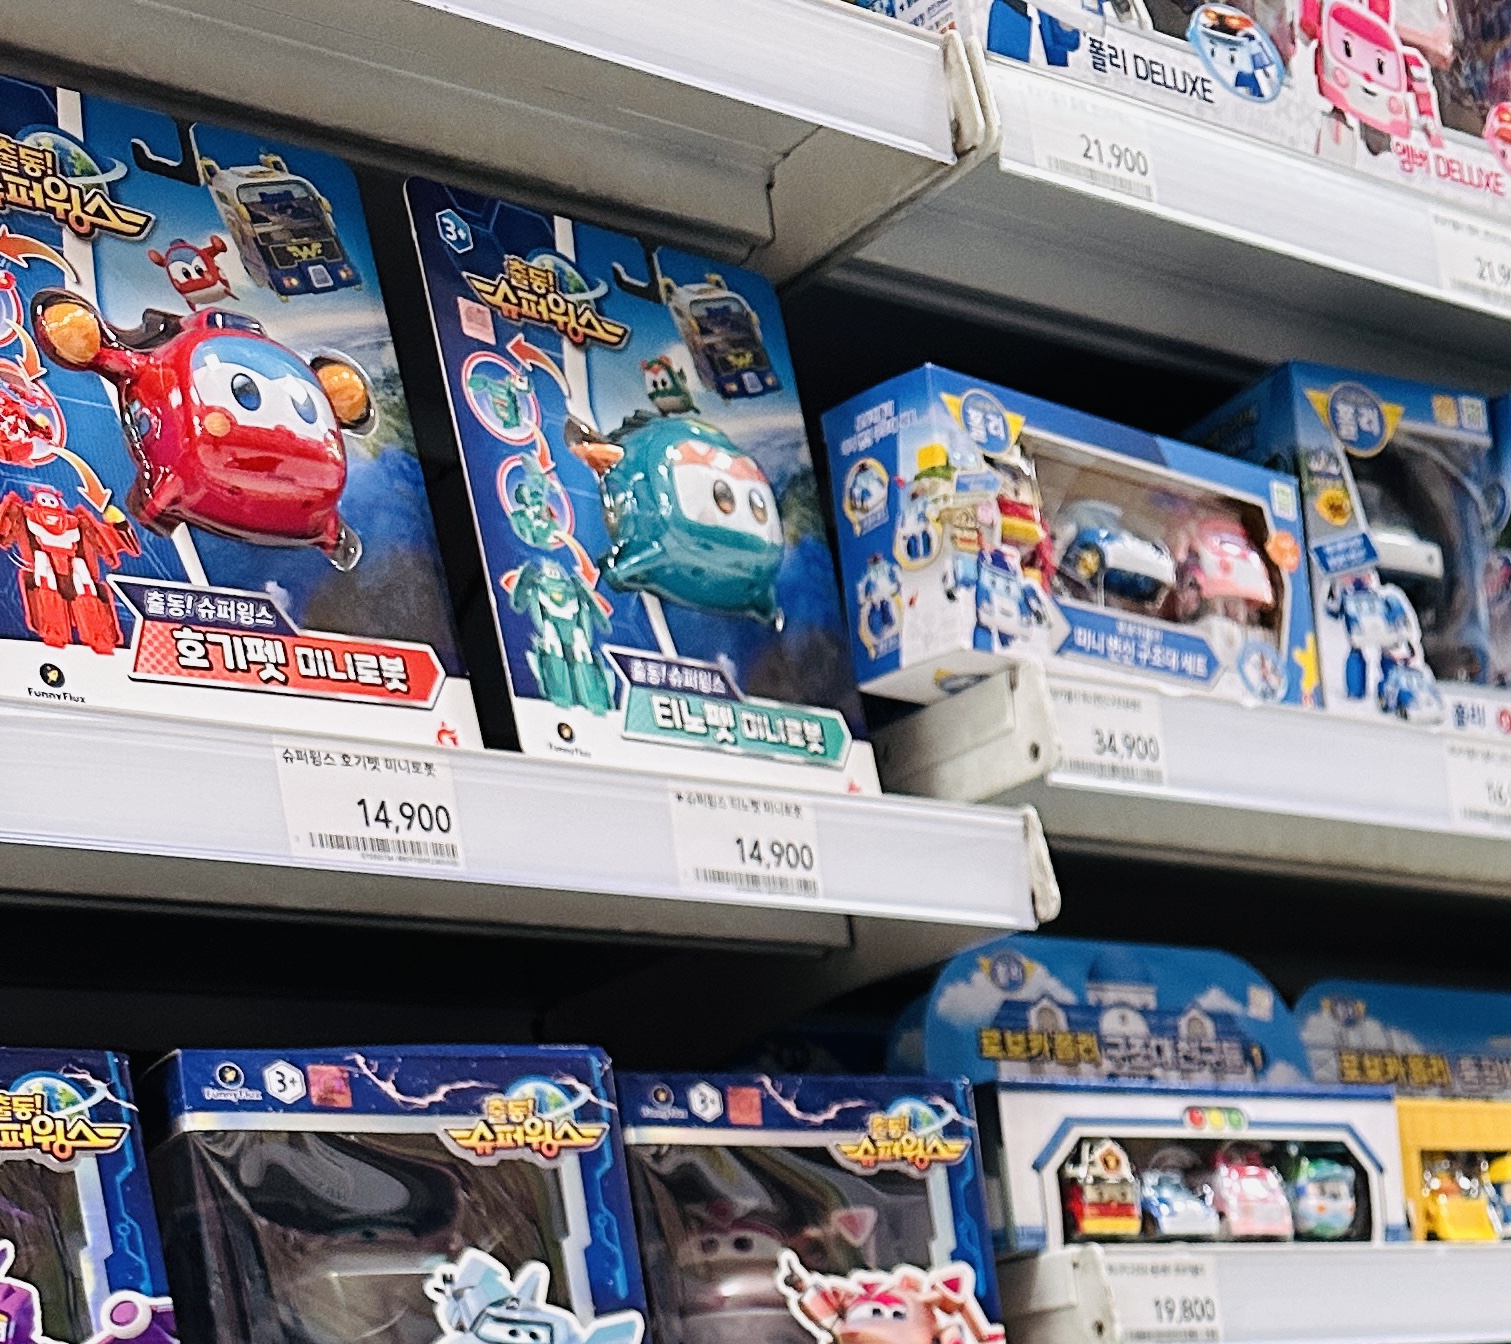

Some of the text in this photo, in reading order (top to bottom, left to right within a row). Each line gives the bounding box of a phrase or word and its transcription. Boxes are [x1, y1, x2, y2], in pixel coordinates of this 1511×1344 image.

[1089, 36, 1214, 103] 폴리 DELUXE
[1080, 133, 1149, 176] 21,900
[1435, 154, 1506, 195] DELUXE
[0, 173, 148, 236] 퍼윙스
[441, 216, 466, 241] 3+
[509, 258, 556, 292] 출동!
[470, 277, 626, 344] 슈퍼윙스
[145, 590, 276, 627] 출동! 슈퍼윙스
[174, 627, 409, 693] 호기펫 미니로봇
[668, 667, 727, 694] 슈퍼윙스
[653, 695, 825, 755] 티노펫 미니로봇
[1093, 728, 1160, 762] 34,900
[357, 798, 450, 834] 14,900
[735, 837, 814, 870] 14,900
[275, 1069, 299, 1093] 3+
[447, 1118, 605, 1159] 슈퍼윙스
[838, 1135, 969, 1170] 슈퍼윙스
[1153, 1297, 1216, 1323] 19,800
